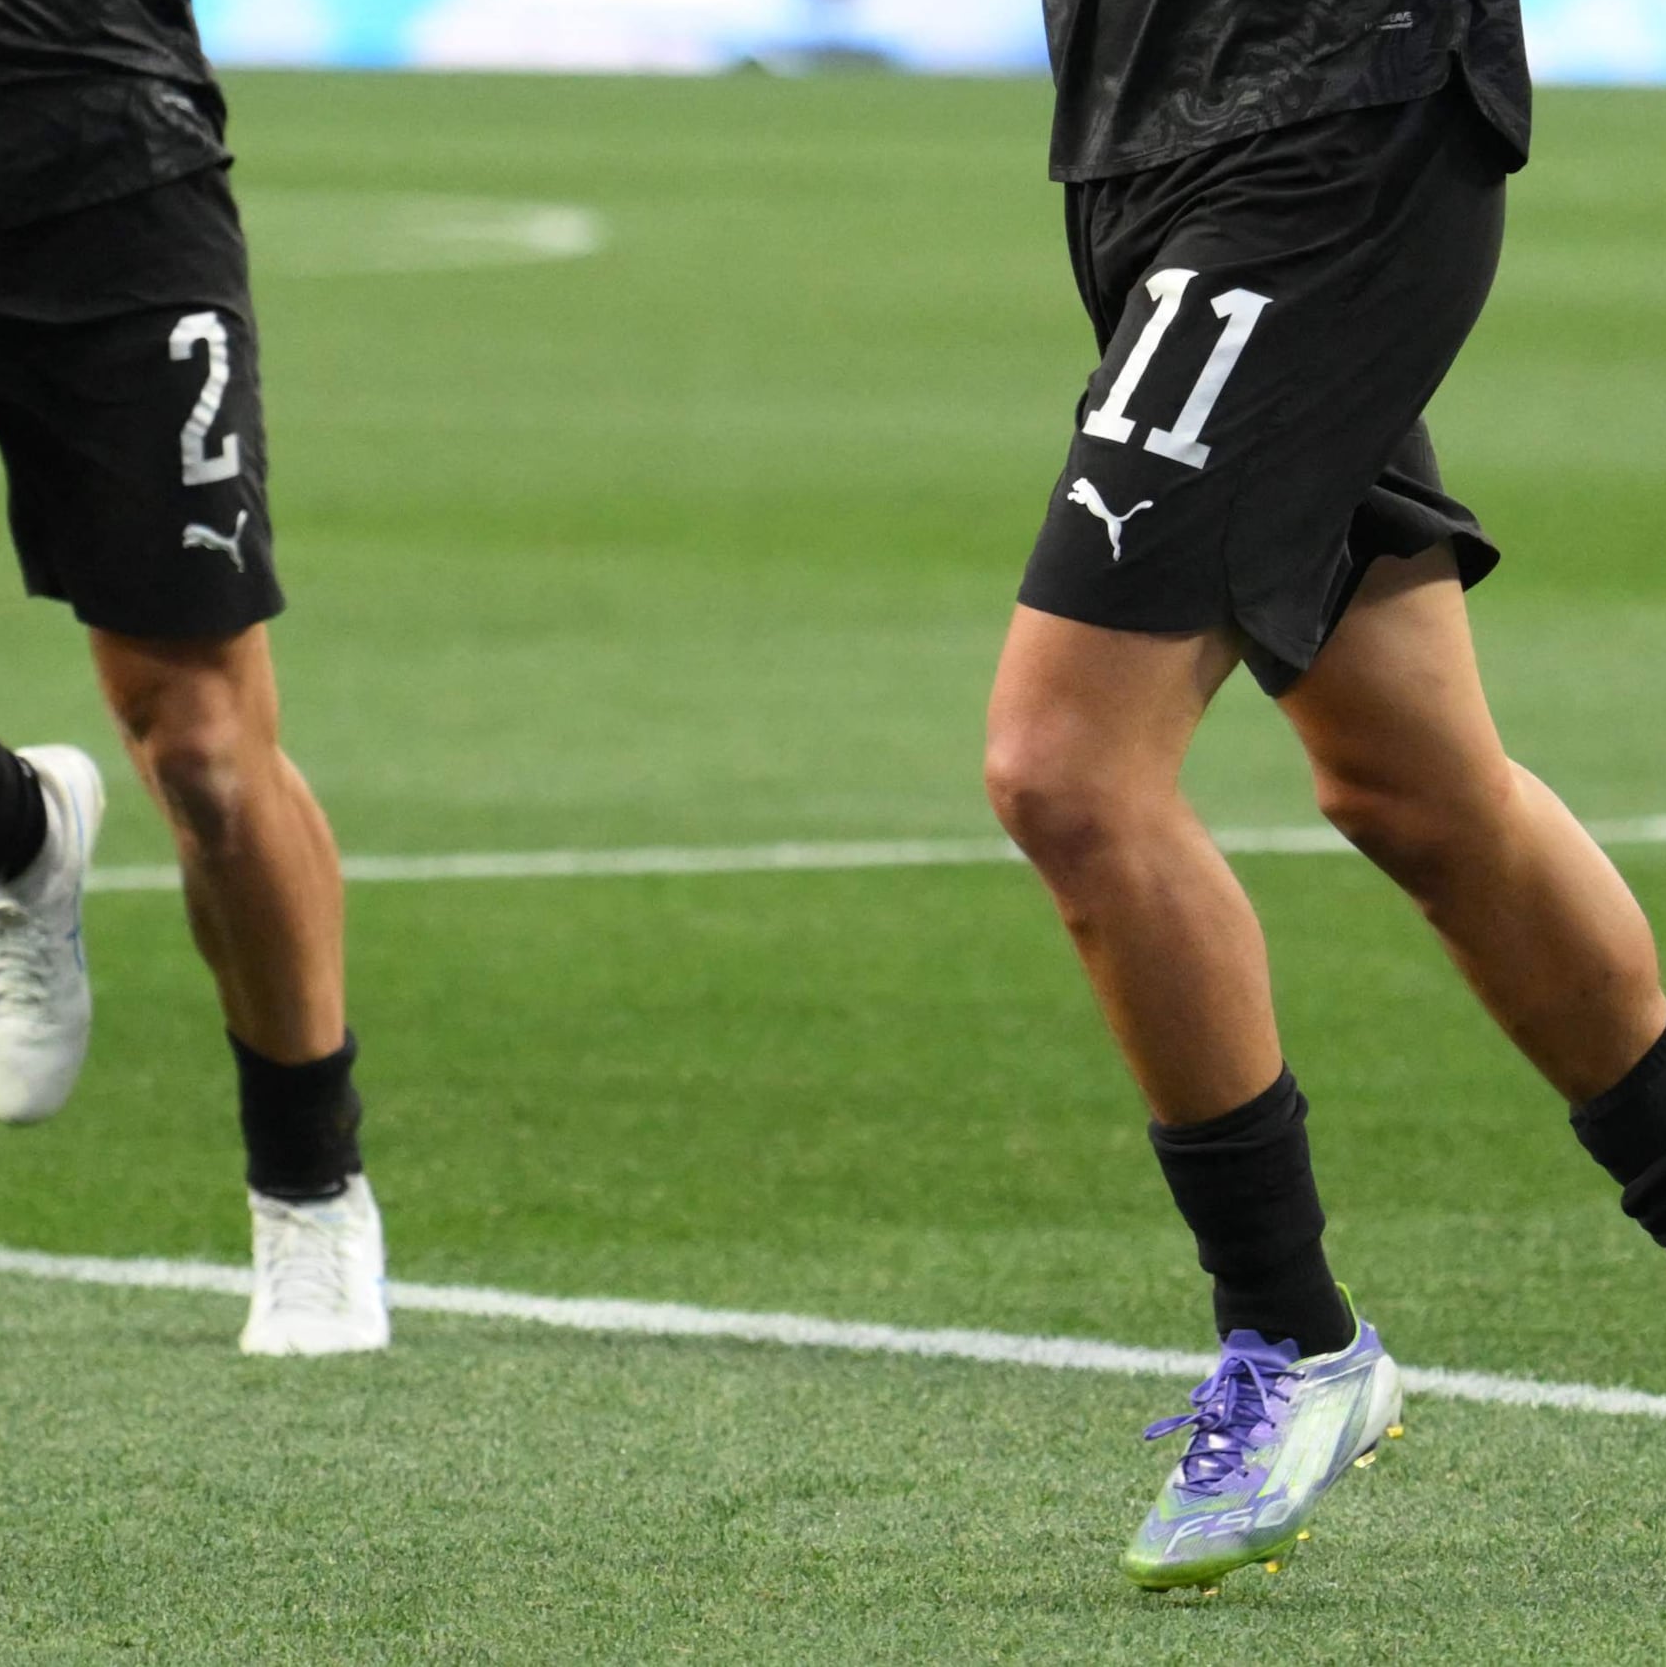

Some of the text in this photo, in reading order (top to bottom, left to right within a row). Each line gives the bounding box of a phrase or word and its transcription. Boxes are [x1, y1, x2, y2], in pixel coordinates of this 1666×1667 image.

[168, 311, 240, 487] 2
[1082, 268, 1274, 470] 11
[1164, 1498, 1291, 1556] F50
